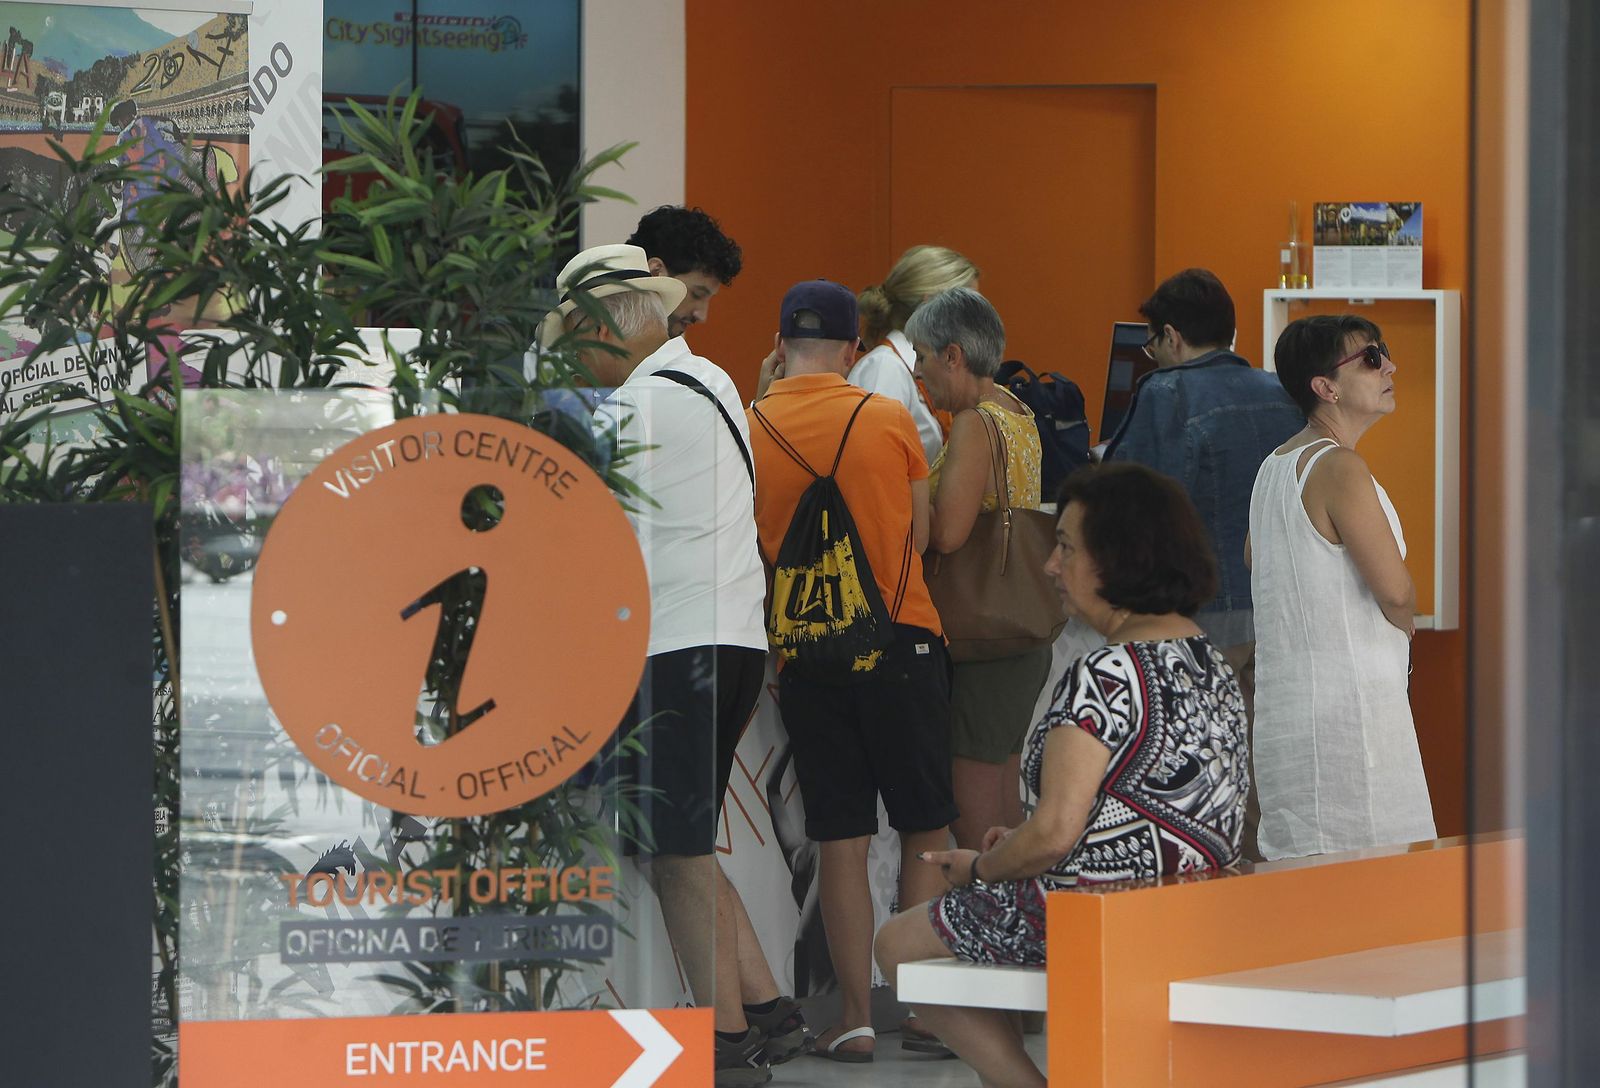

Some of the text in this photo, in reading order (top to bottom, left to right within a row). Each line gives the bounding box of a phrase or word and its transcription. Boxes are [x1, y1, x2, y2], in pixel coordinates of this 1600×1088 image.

[327, 18, 367, 44] City
[373, 22, 500, 52] Sightseeing
[1, 361, 59, 386] OFICIAL
[64, 355, 85, 373] DE
[323, 430, 578, 499] VISITOR CENTRE
[785, 573, 844, 623] CAT
[315, 723, 591, 800] OFICIAL OFFICIAL
[280, 866, 614, 909] TOURIST OFFICE
[287, 927, 411, 955] OFICINA
[420, 925, 459, 953] DE
[346, 1038, 547, 1076] ENTRANCE
